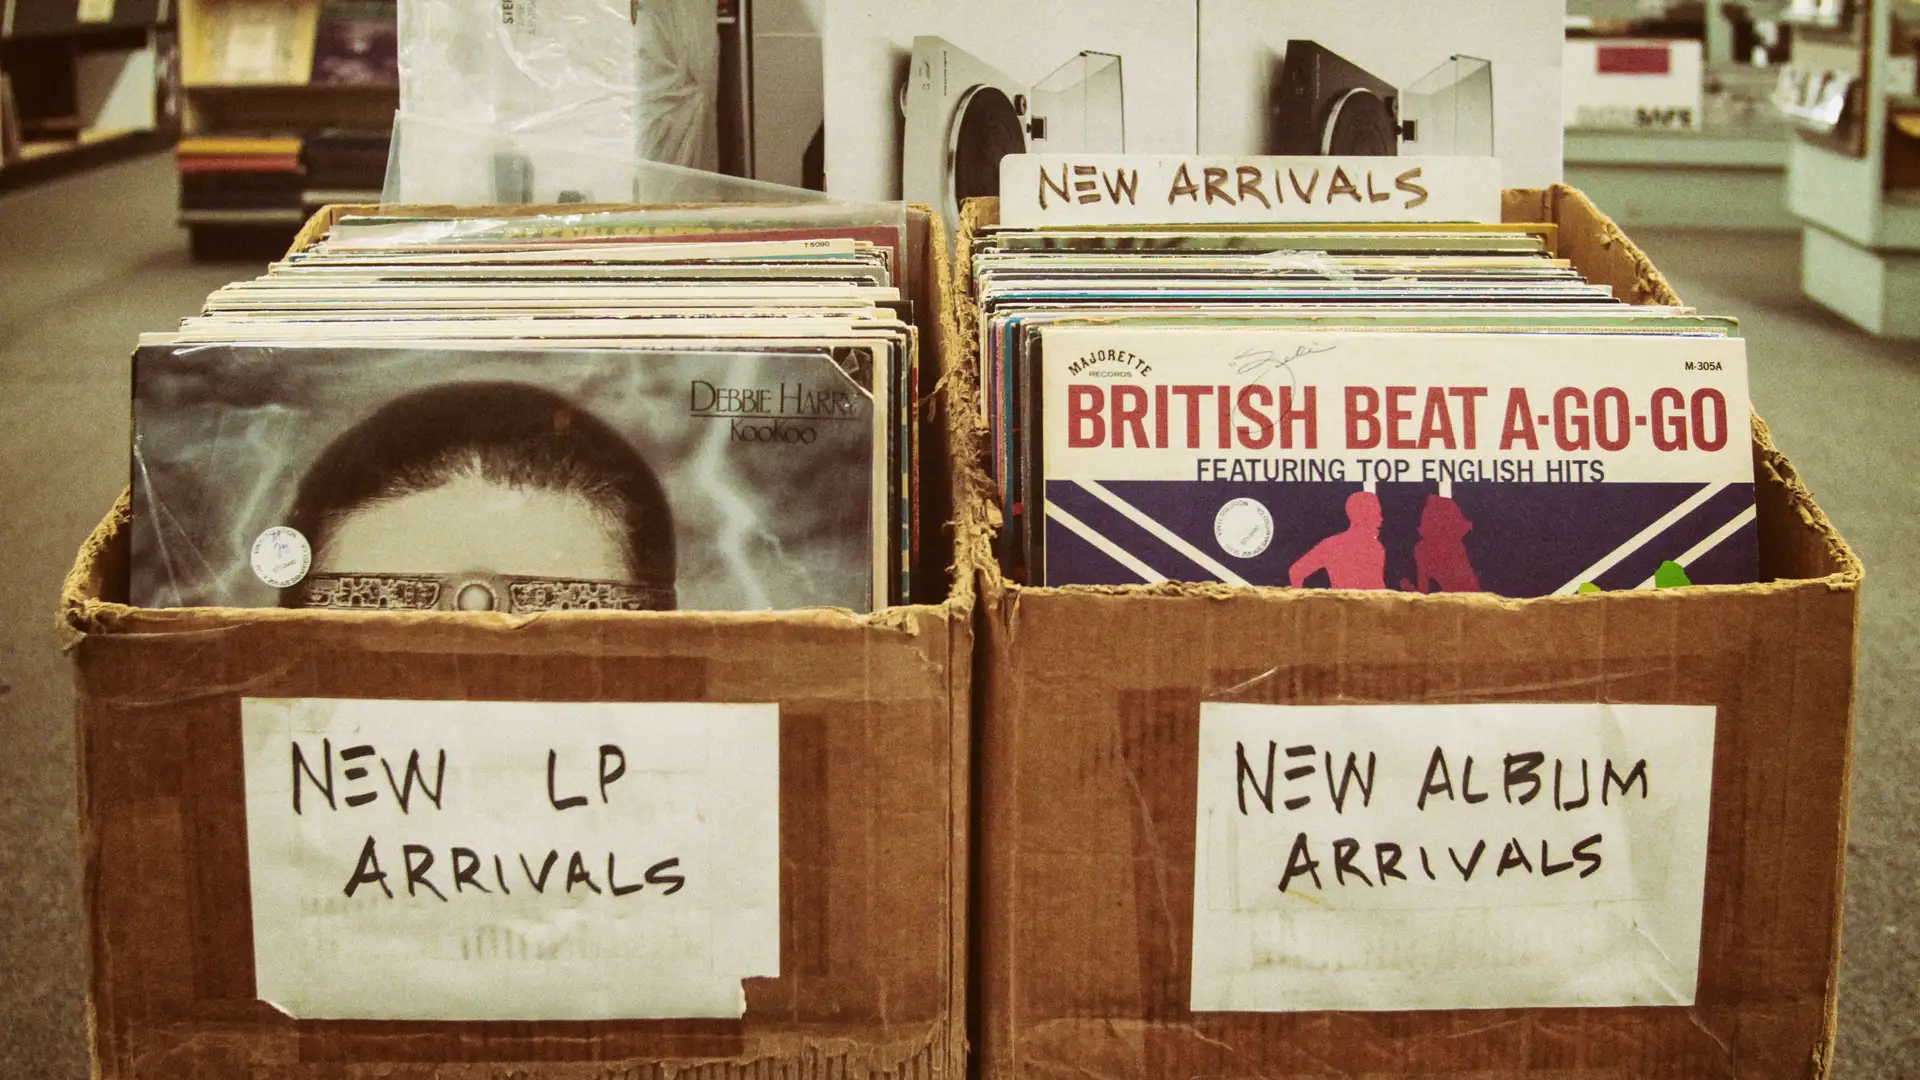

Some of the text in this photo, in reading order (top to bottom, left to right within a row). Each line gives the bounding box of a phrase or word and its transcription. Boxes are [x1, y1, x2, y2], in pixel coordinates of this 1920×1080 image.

[1039, 162, 1428, 210] NEW ARRIVALS
[1068, 349, 1153, 377] MAJORETTE
[1684, 361, 1723, 371] M-305A
[1068, 384, 1317, 450] BRITISH
[1344, 386, 1488, 450] BEAT
[1500, 386, 1728, 452] A-GO-GO
[1197, 458, 1605, 483] FEATURING TOP ENGLISH HITS
[292, 738, 627, 815] NEW LP
[1235, 740, 1648, 815] NEW ALBUM
[344, 836, 685, 902] ARRIVALS
[1278, 832, 1603, 892] ARRIVALS
